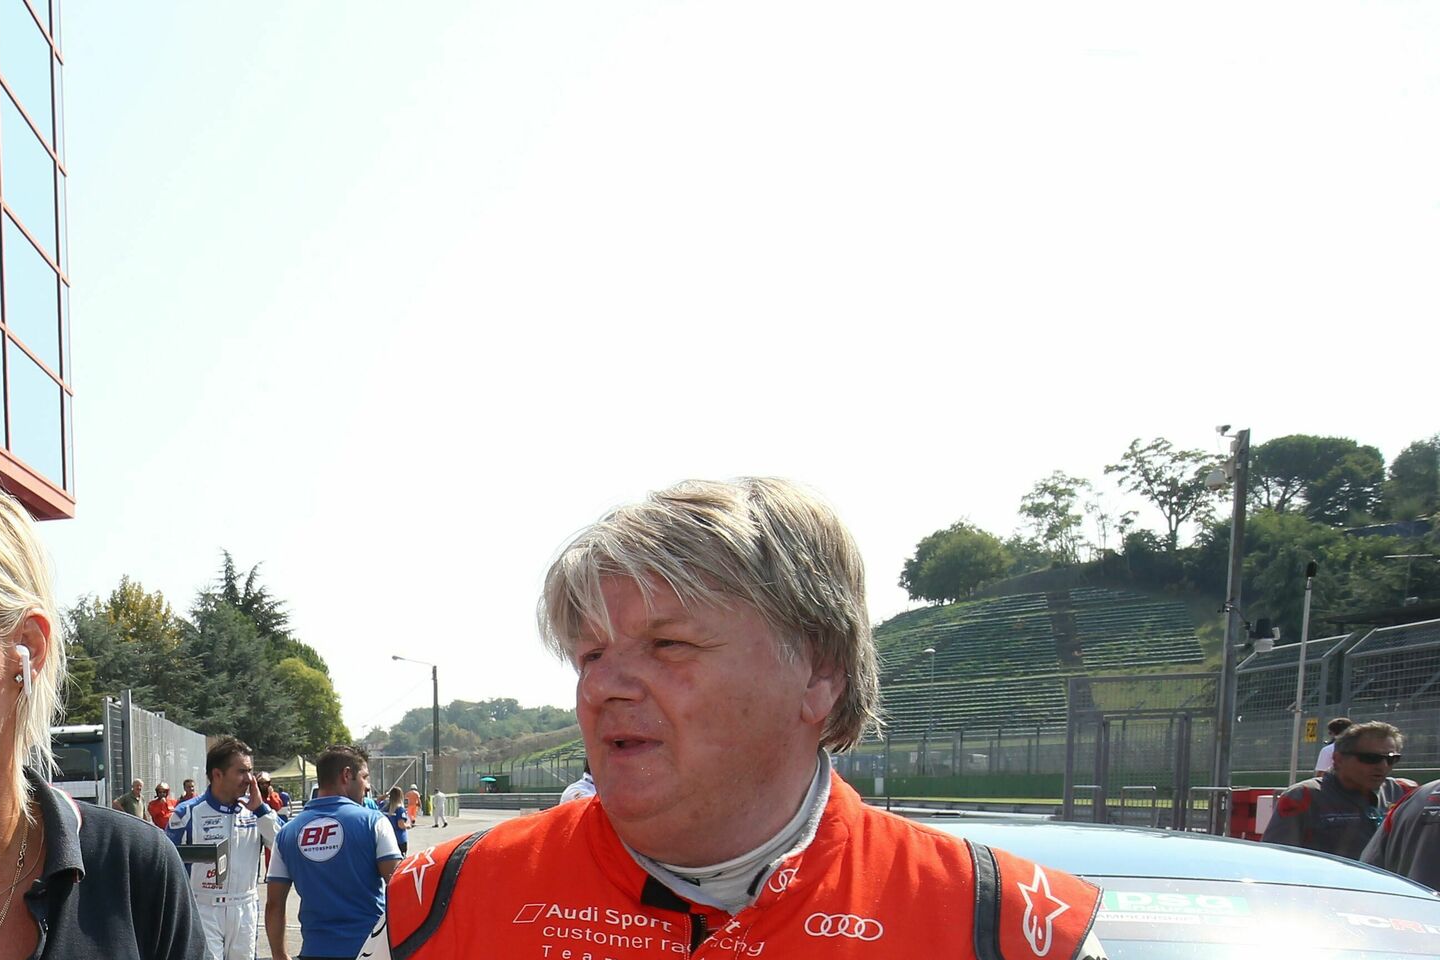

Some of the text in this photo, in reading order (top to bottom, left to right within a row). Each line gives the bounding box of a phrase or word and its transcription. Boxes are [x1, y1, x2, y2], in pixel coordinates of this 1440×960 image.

[300, 824, 339, 846] BF
[303, 844, 339, 852] MOTORSPORT
[545, 904, 672, 933] Audi Sport
[542, 925, 654, 950] customer
